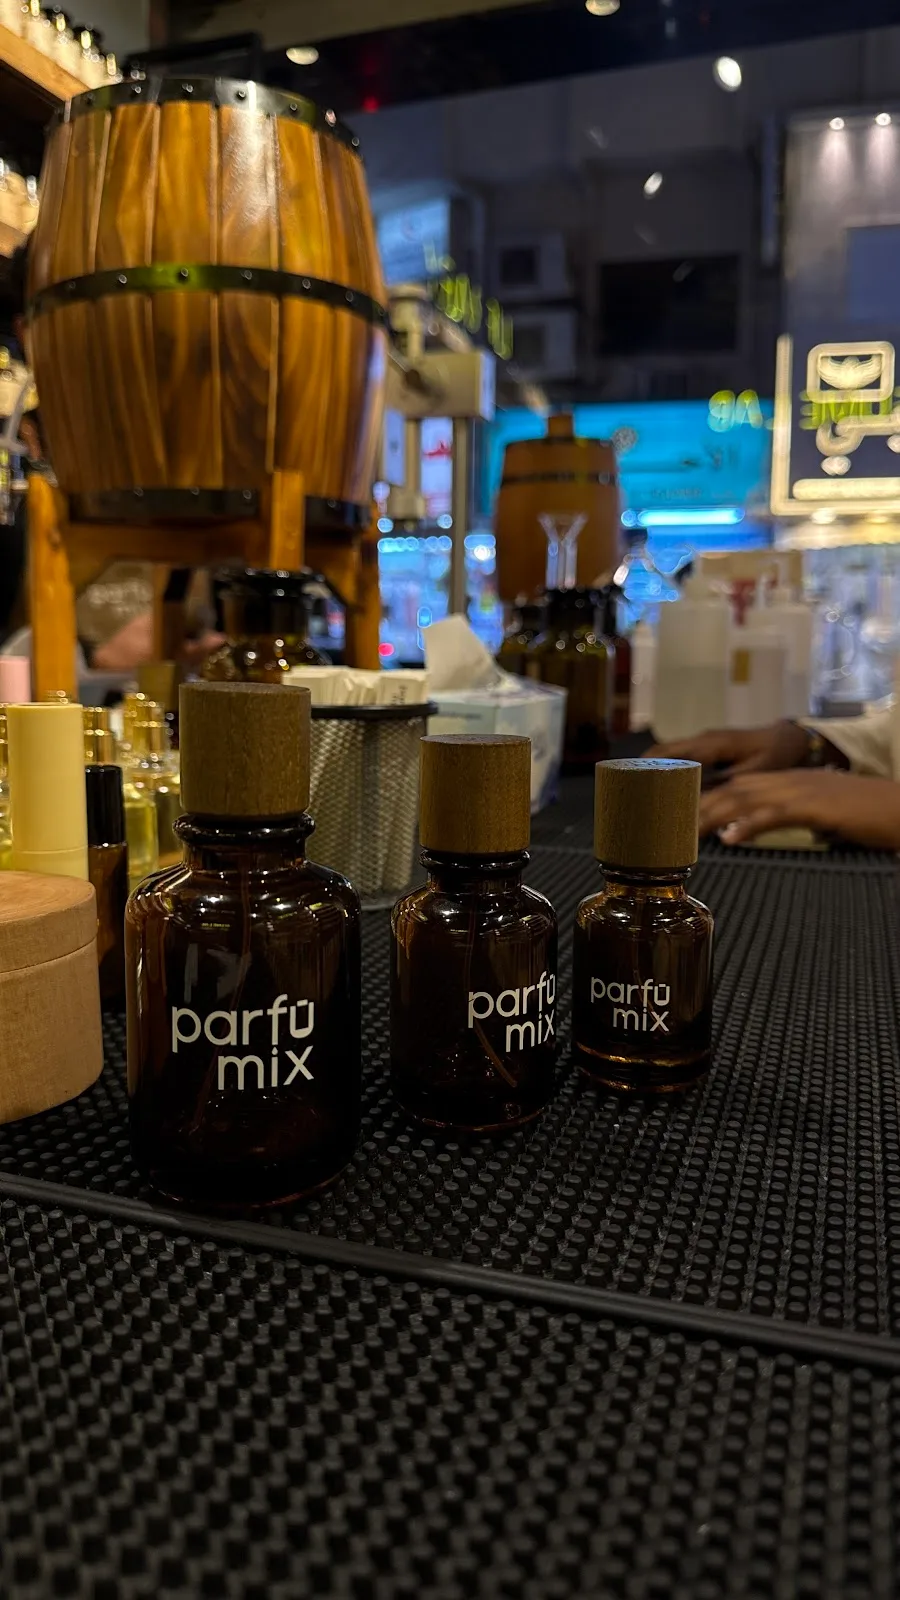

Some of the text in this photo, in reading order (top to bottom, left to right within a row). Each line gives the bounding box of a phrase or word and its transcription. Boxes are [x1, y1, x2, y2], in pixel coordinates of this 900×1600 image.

[505, 1009, 555, 1052] mix
[612, 1007, 669, 1031] mix
[218, 1046, 314, 1090] mix
